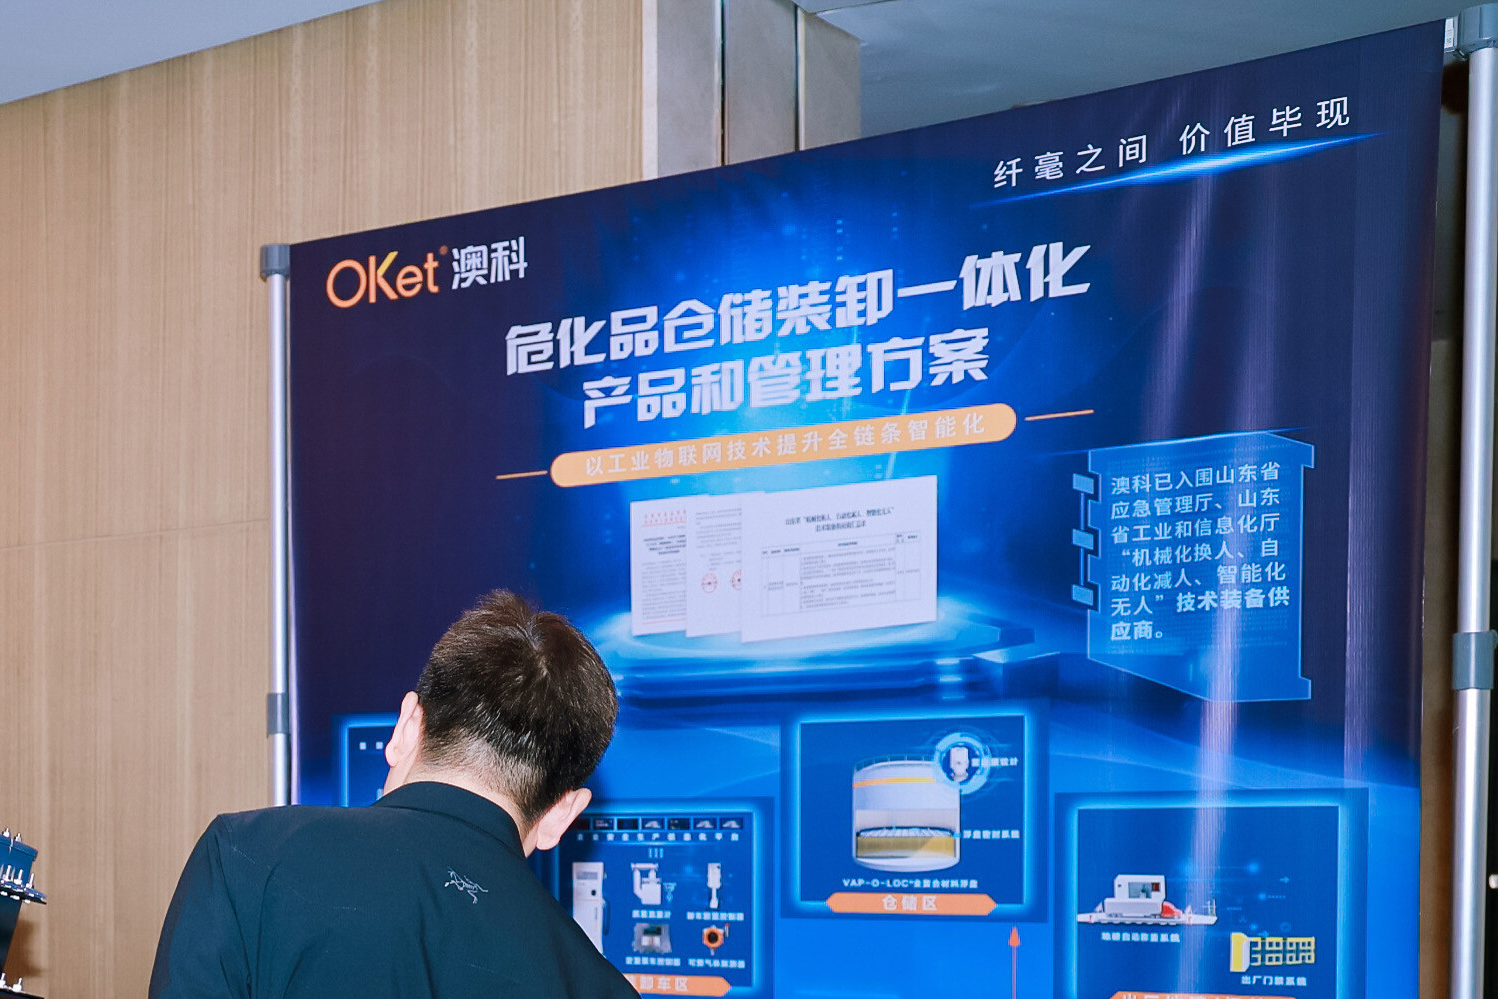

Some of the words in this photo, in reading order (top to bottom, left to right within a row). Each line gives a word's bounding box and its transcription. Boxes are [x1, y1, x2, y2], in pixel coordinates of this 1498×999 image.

[993, 132, 1148, 188] 纤毫之间
[1179, 96, 1351, 156] 价值毕现
[451, 237, 528, 289] 澳科
[505, 241, 1091, 375] 危化品仓储装卸一体化
[584, 327, 989, 429] 产品和管理方案
[586, 414, 985, 476] 以工业物联网技术提升全链条智能化
[1111, 462, 1280, 495] 澳科已入围山东省
[1111, 512, 1280, 544] 省工业和信息化厅
[1110, 562, 1286, 592] 动化减人、智能化
[1110, 620, 1163, 641] 应商。
[882, 894, 938, 911] 仓储区
